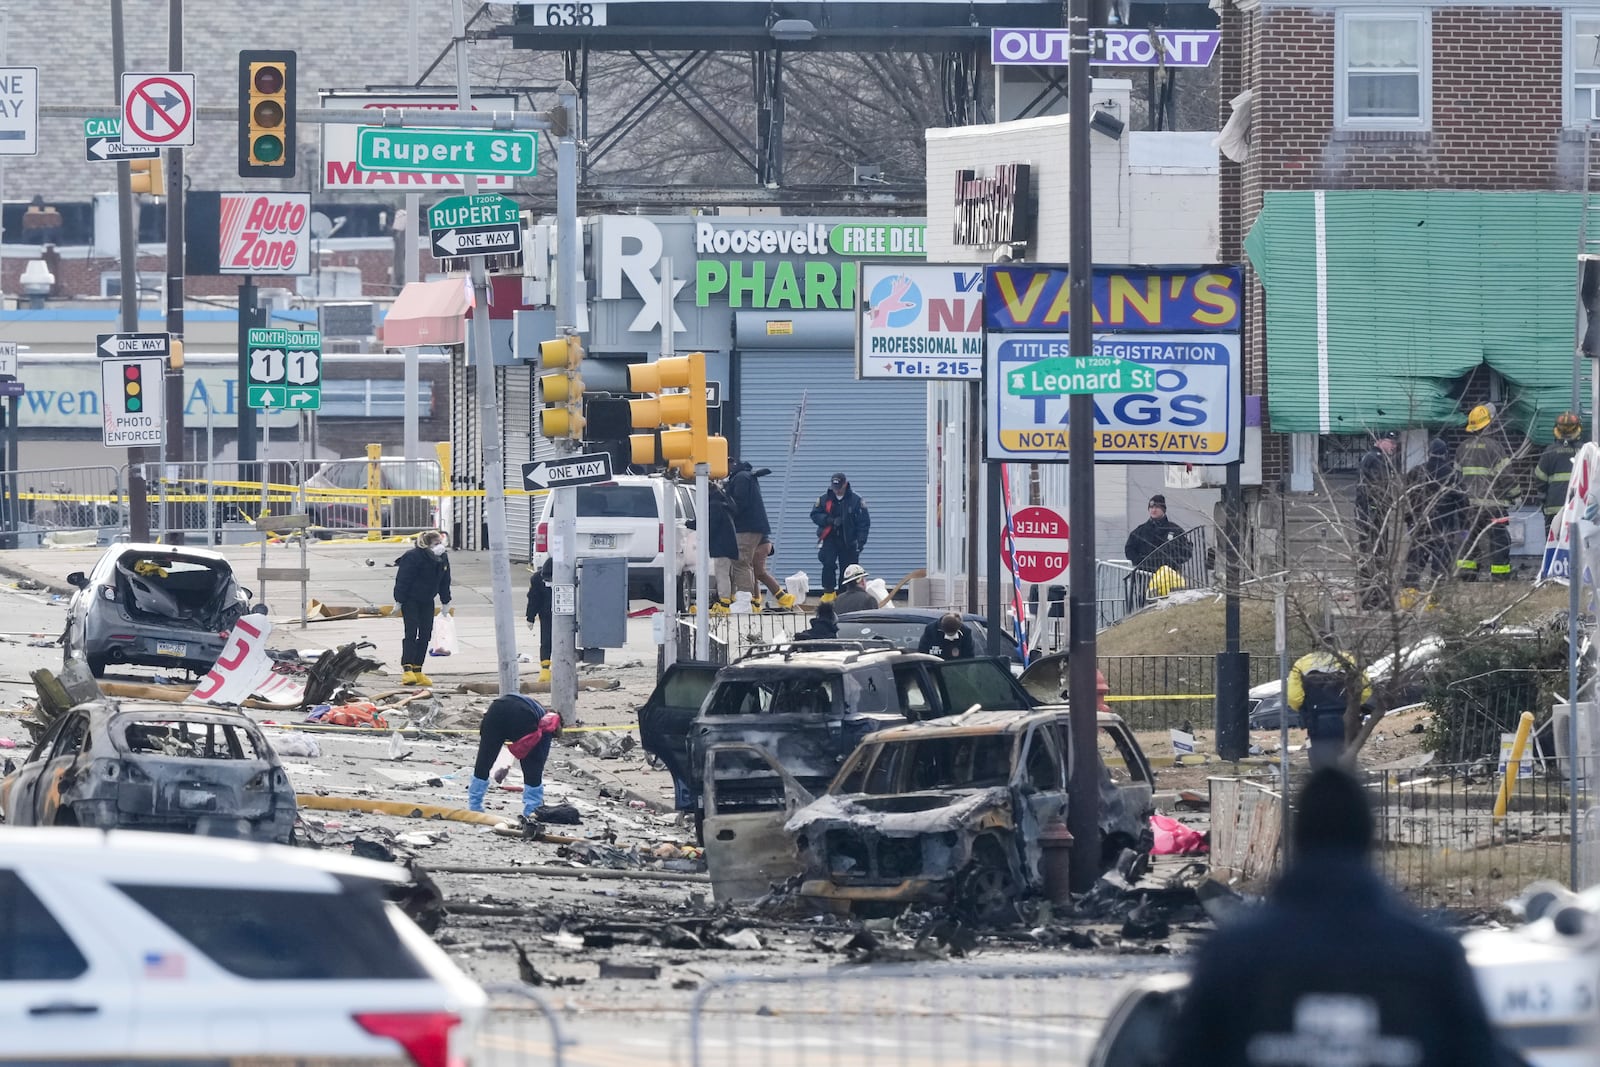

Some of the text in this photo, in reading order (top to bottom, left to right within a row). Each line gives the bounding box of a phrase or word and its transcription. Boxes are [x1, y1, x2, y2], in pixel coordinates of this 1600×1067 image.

[546, 3, 594, 26] 638
[1000, 32, 1209, 62] OUTRONT
[0, 76, 23, 94] NE
[0, 99, 24, 118] AY
[86, 119, 121, 135] CALV
[372, 137, 522, 164] Rupert St
[475, 196, 495, 204] 7200
[245, 196, 305, 231] Auto
[433, 204, 516, 227] RUPERT ST
[458, 232, 510, 247] ONE WAY
[696, 222, 828, 254] Roosevelt
[843, 227, 886, 252] FREE
[231, 232, 296, 267] Zone
[994, 271, 1237, 326] VAN'S
[118, 339, 162, 350] ONE WAY
[251, 331, 285, 343] NORTH
[287, 334, 318, 345] SOUTH
[872, 336, 957, 354] PROFESSIONAL
[1012, 343, 1069, 358] TITLES
[262, 354, 271, 377] 1
[296, 356, 305, 379] 1
[894, 361, 982, 375] Tel: 215-
[1075, 358, 1111, 369] N 7200
[1032, 368, 1121, 391] Leonard
[1131, 369, 1152, 388] St
[116, 416, 152, 428] PHOTO
[107, 430, 161, 442] ENFORCED
[1019, 432, 1067, 448] NOTA
[548, 462, 601, 480] ONE WAY
[1016, 521, 1058, 535] ENTER
[1018, 555, 1063, 569] DO NO
